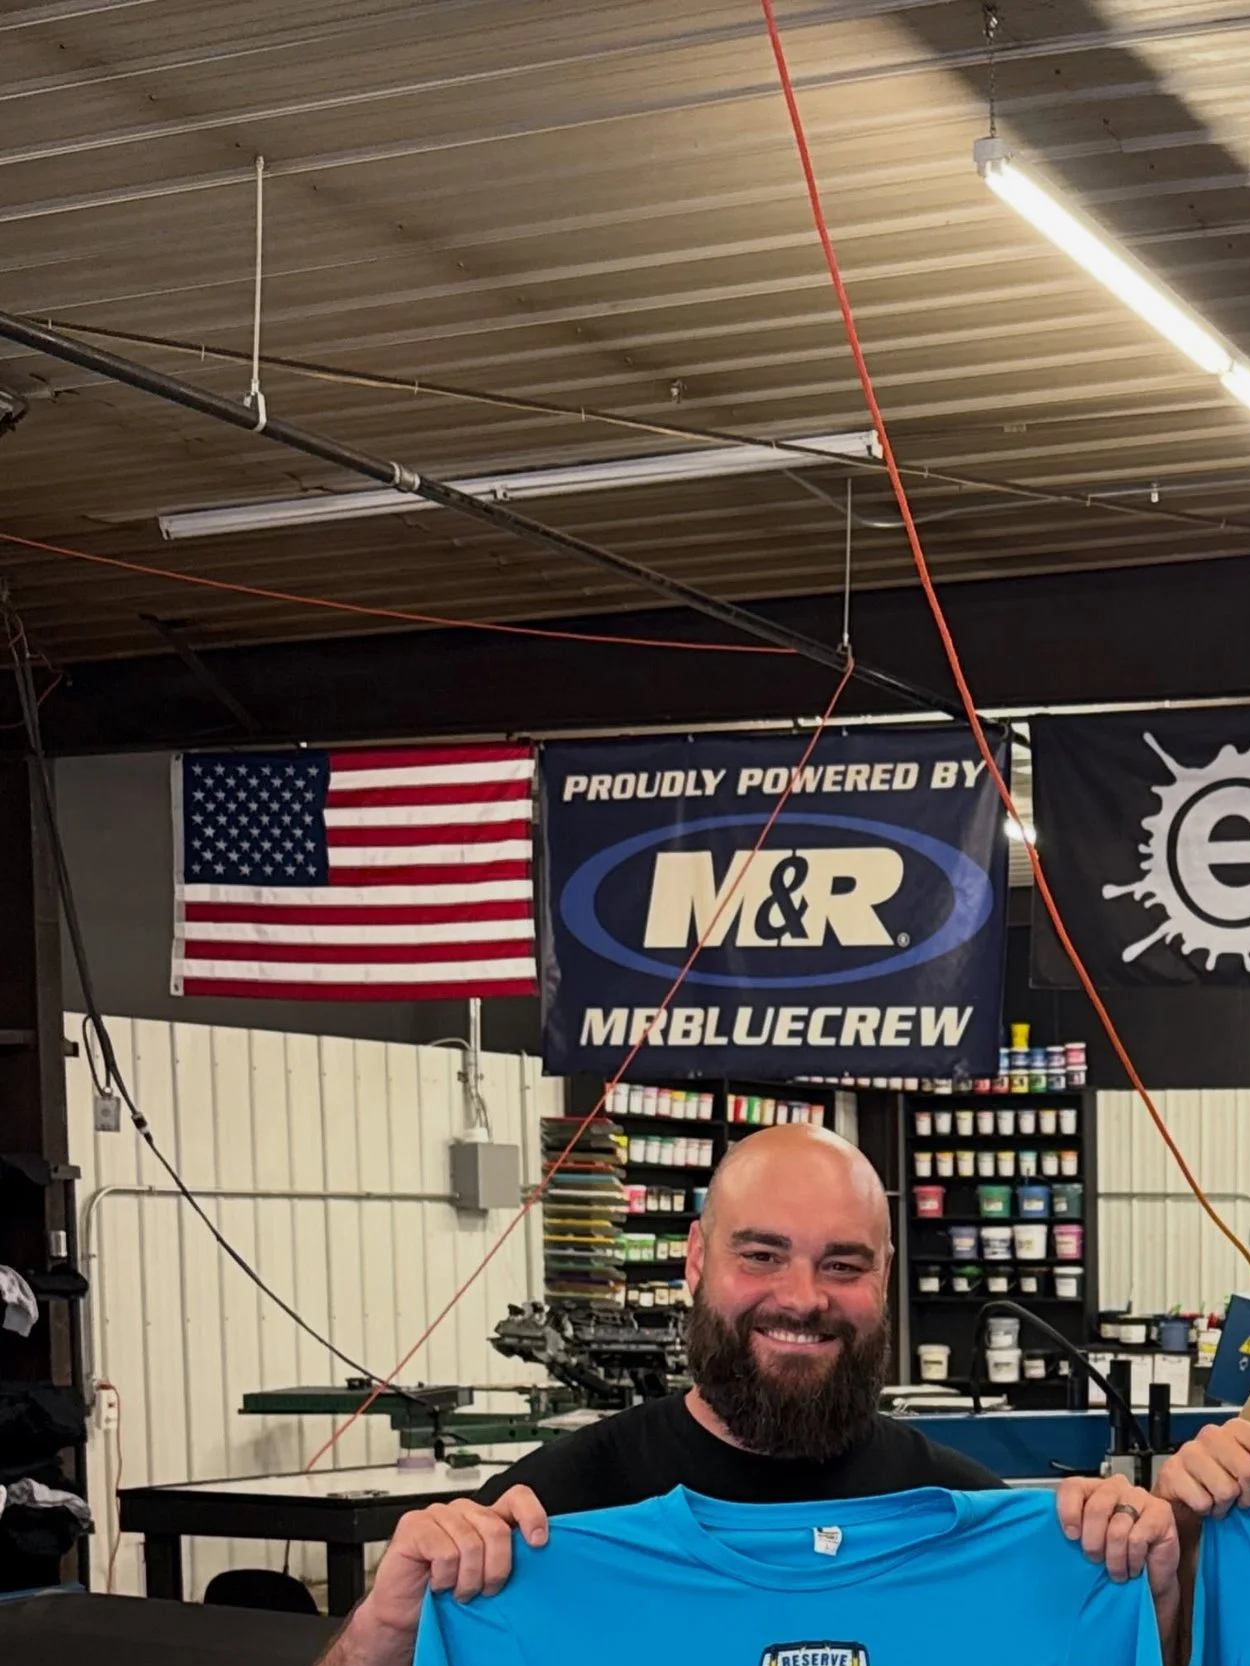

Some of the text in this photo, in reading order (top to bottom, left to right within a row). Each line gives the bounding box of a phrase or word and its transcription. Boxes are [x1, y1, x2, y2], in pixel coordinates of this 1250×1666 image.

[563, 760, 987, 802] PROUDLY POWERED BY
[643, 847, 904, 948] M&R
[580, 1006, 973, 1047] MRBLUECREW
